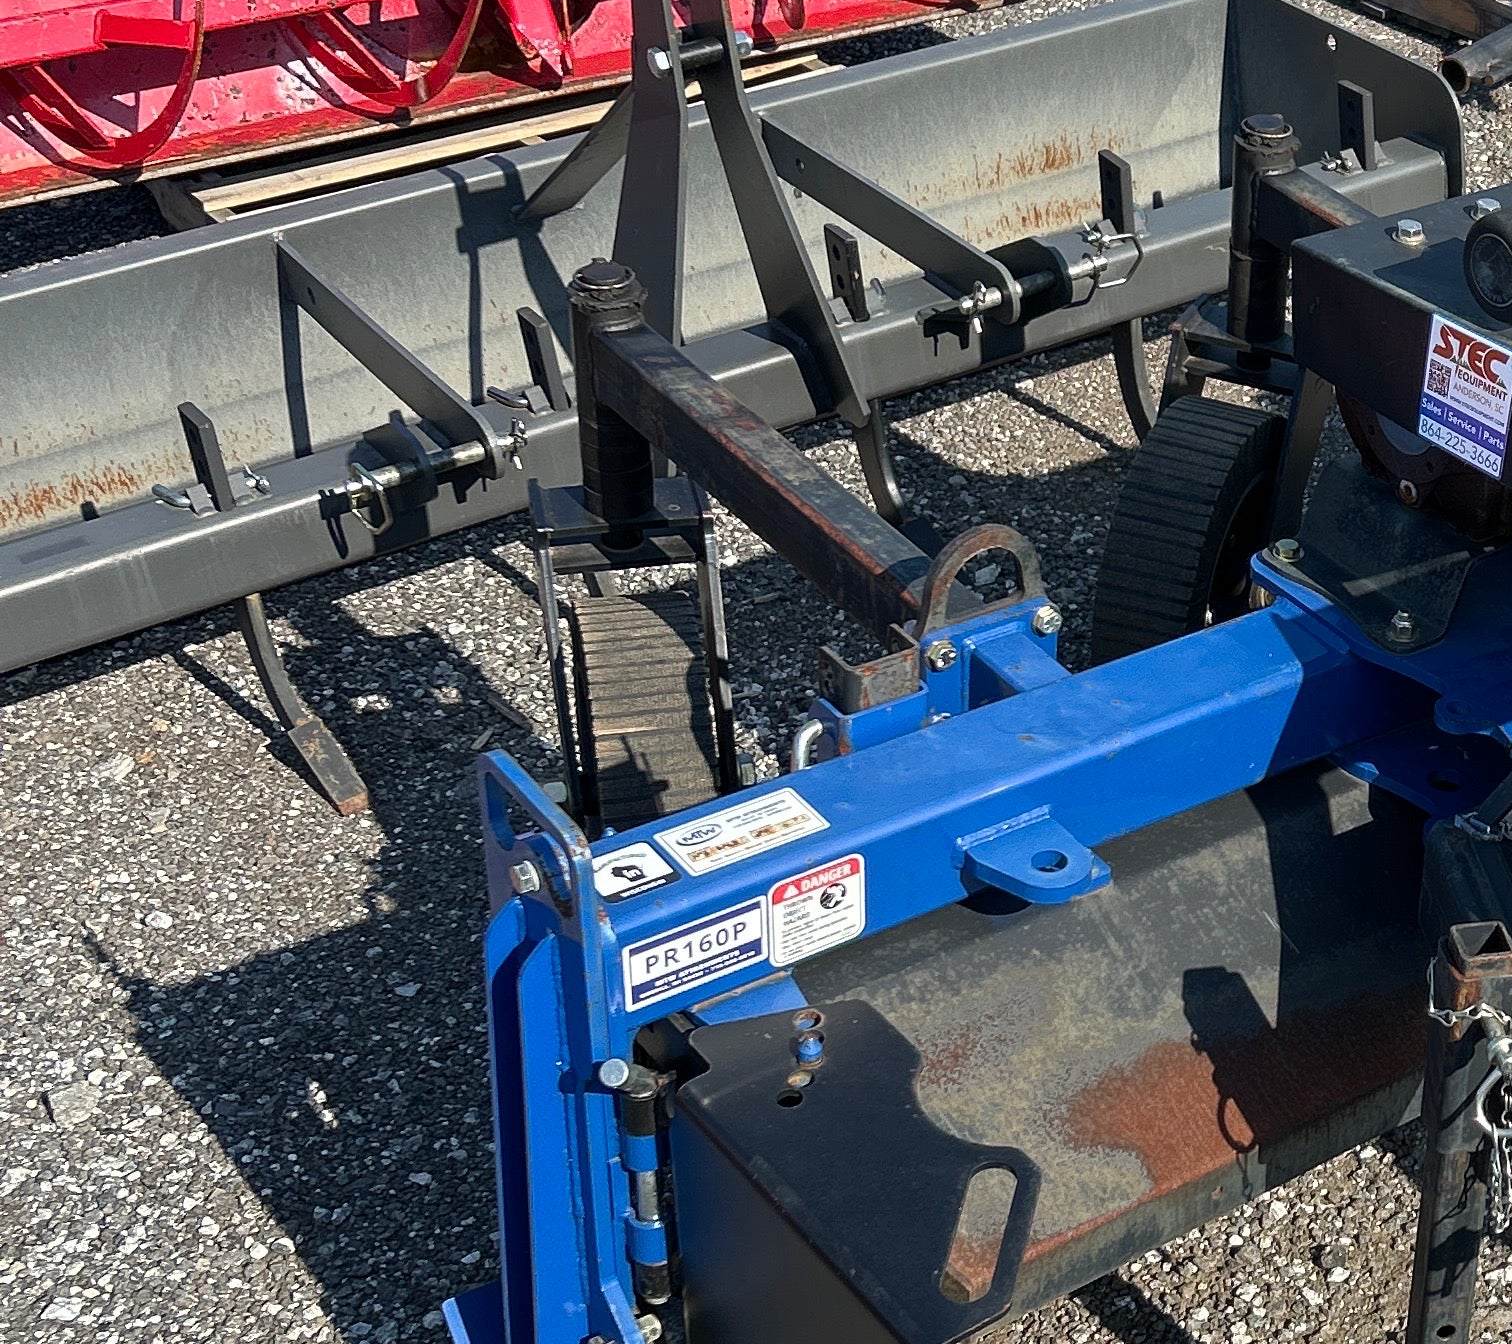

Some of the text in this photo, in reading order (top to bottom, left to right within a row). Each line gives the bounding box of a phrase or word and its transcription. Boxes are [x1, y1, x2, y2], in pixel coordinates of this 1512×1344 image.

[1432, 324, 1510, 385] STEC
[1452, 383, 1505, 415] ANDERSON, SC
[1457, 370, 1508, 402] EQUIPMENT
[1421, 398, 1504, 450] Sales Service Parts
[1421, 419, 1499, 473] 864-225-3666
[681, 825, 718, 844] MTW
[800, 862, 852, 892] DANGER
[645, 921, 747, 974] PR160P
